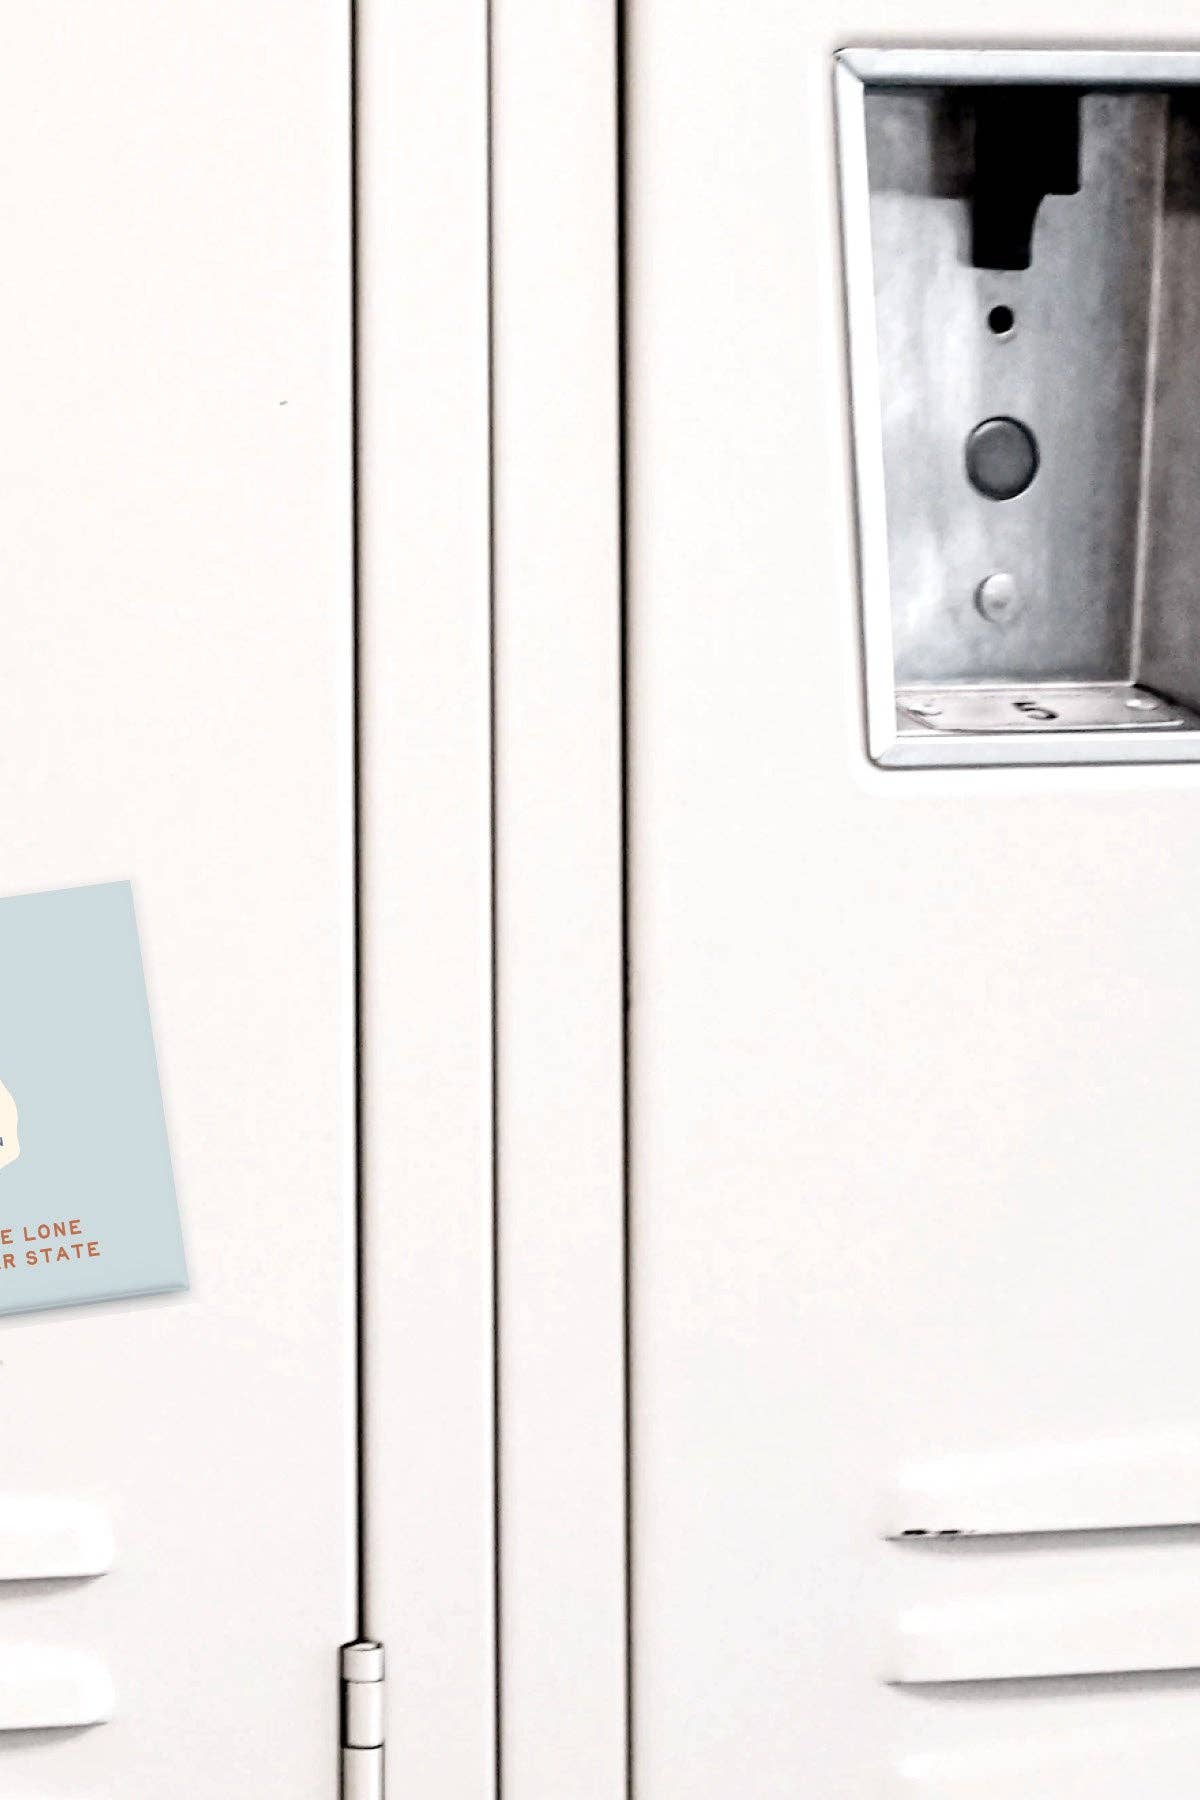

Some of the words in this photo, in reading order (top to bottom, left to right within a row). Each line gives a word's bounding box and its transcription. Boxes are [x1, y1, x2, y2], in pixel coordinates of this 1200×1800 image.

[1010, 701, 1059, 721] 5
[22, 1219, 82, 1242] LONE
[26, 1241, 100, 1267] STATE
